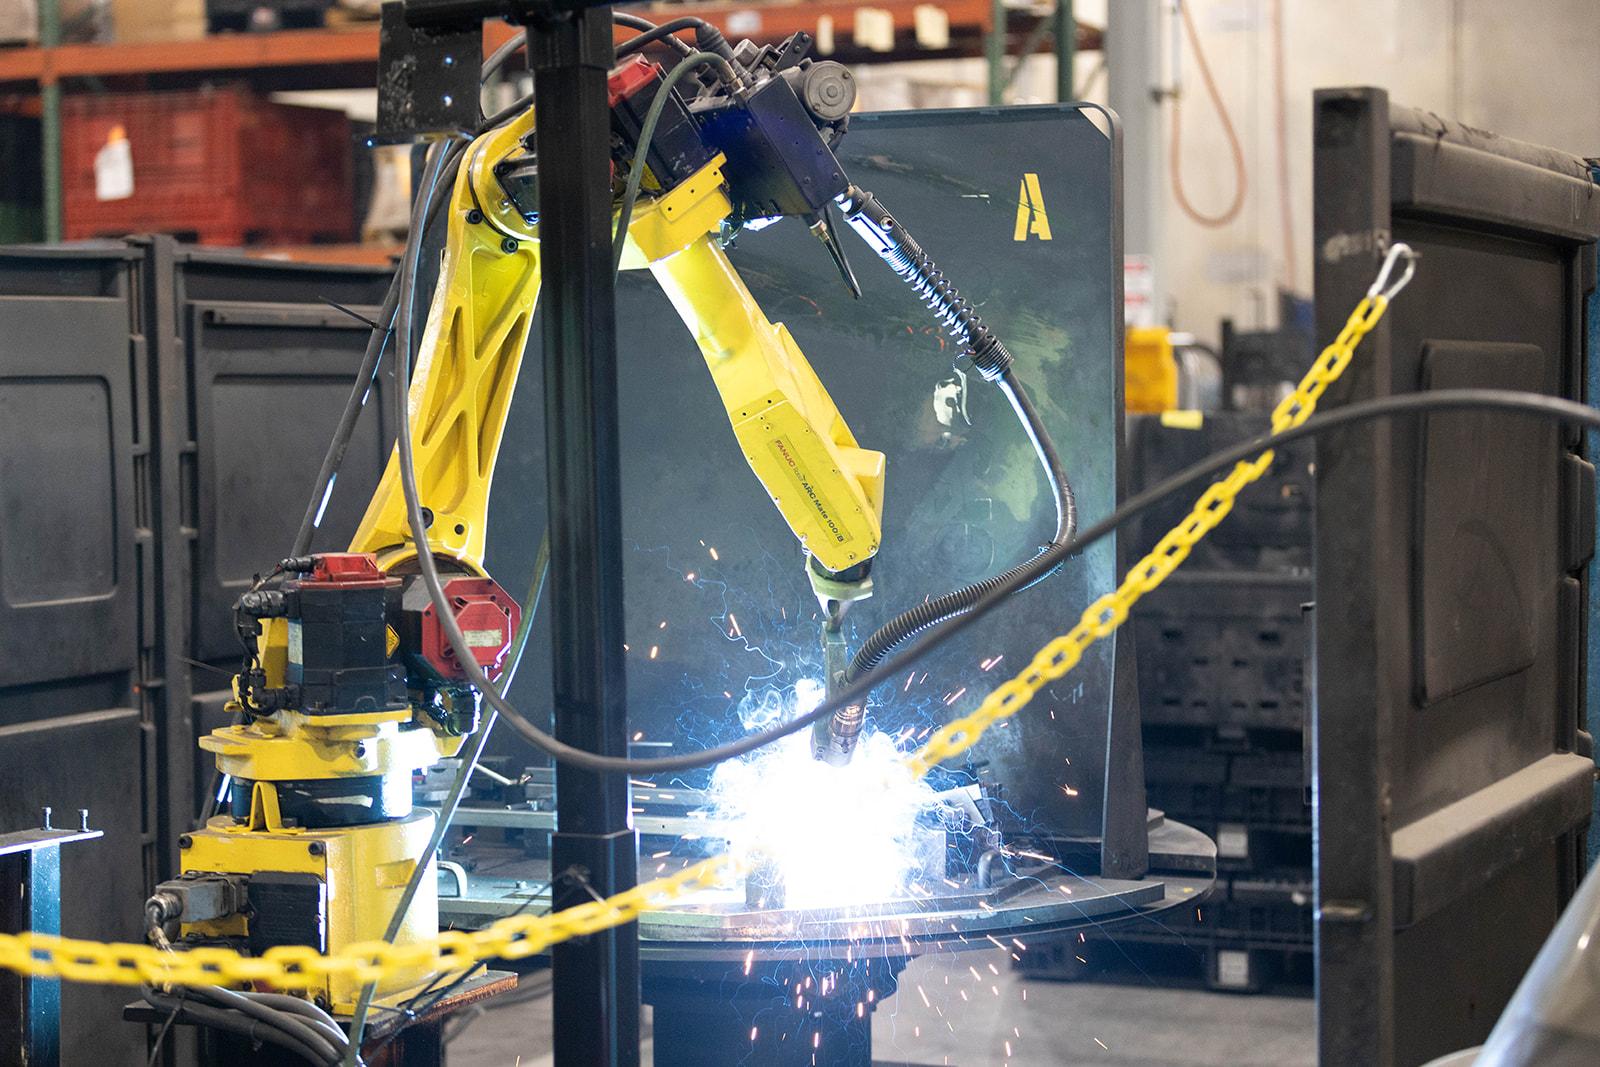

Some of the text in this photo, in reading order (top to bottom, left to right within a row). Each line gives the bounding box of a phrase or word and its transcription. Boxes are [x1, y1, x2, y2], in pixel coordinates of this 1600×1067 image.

[1013, 172, 1053, 241] A
[775, 439, 796, 467] FANUC
[801, 482, 816, 499] ARC
[813, 499, 828, 519] Mate
